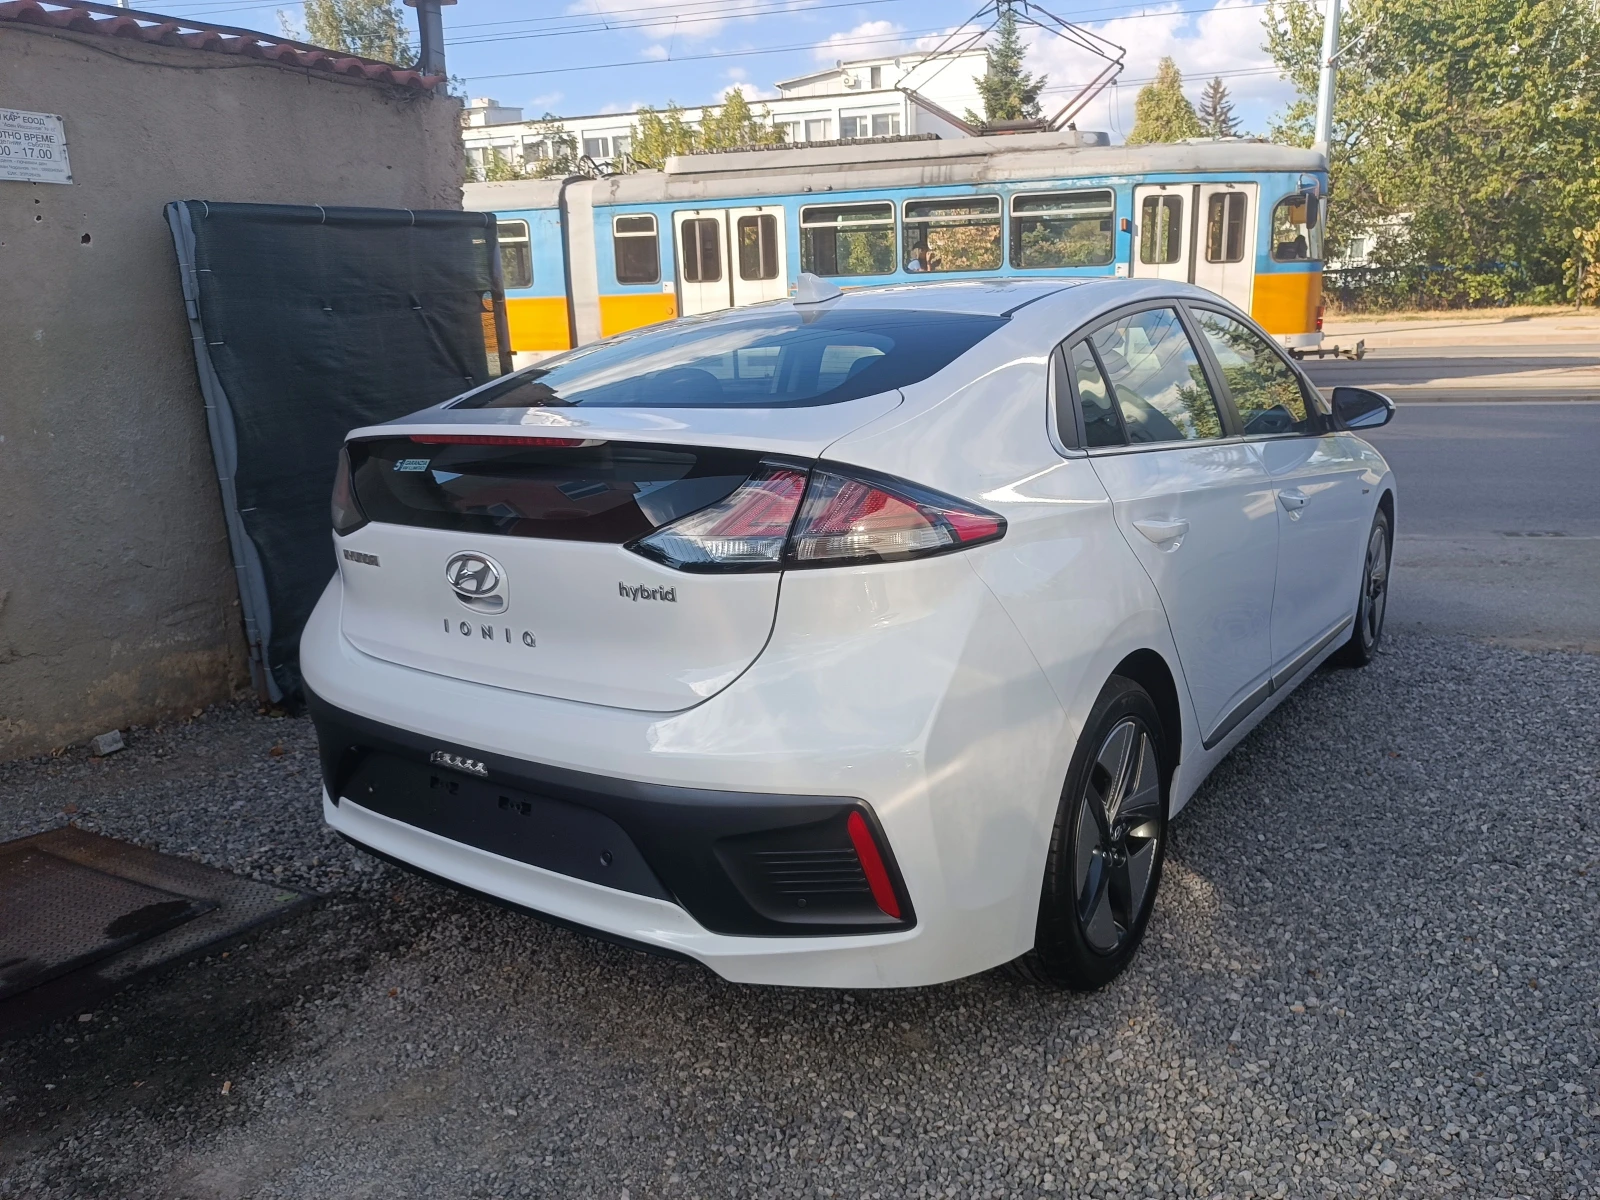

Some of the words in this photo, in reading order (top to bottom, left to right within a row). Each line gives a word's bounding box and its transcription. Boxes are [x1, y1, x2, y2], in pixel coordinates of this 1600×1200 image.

[22, 116, 45, 125] ЕООД
[24, 133, 55, 143] ВРЕМЕ
[22, 147, 52, 159] 17.00
[619, 581, 677, 603] hybrid
[443, 618, 537, 648] IONIQ
